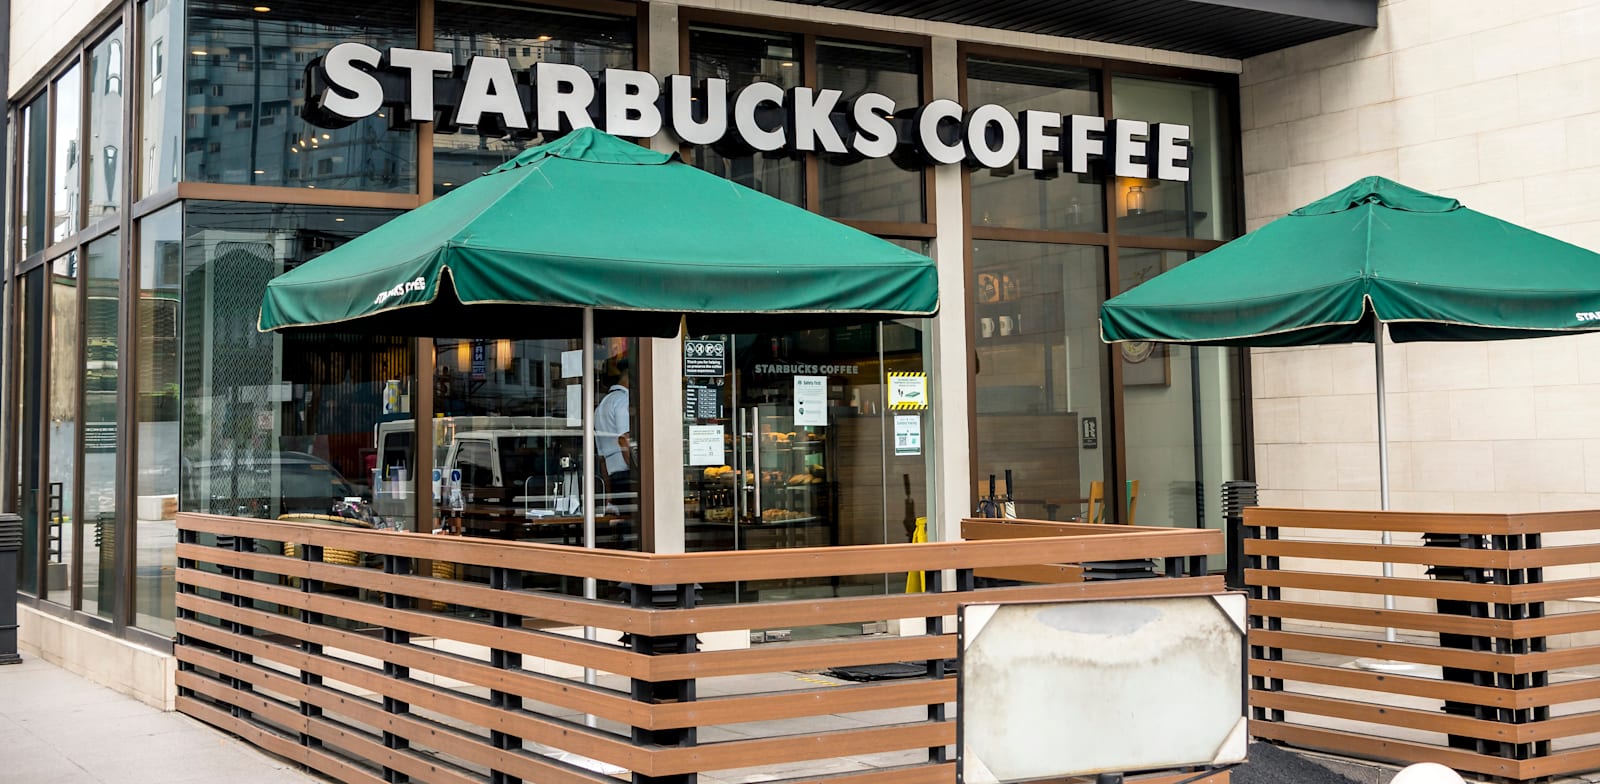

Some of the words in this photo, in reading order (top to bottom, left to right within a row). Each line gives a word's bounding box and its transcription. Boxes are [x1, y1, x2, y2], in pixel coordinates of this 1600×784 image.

[321, 41, 898, 159] STARBUCKS
[919, 99, 1190, 182] COFFEE
[754, 363, 818, 374] STARBUCKS
[819, 364, 859, 375] COFFEE
